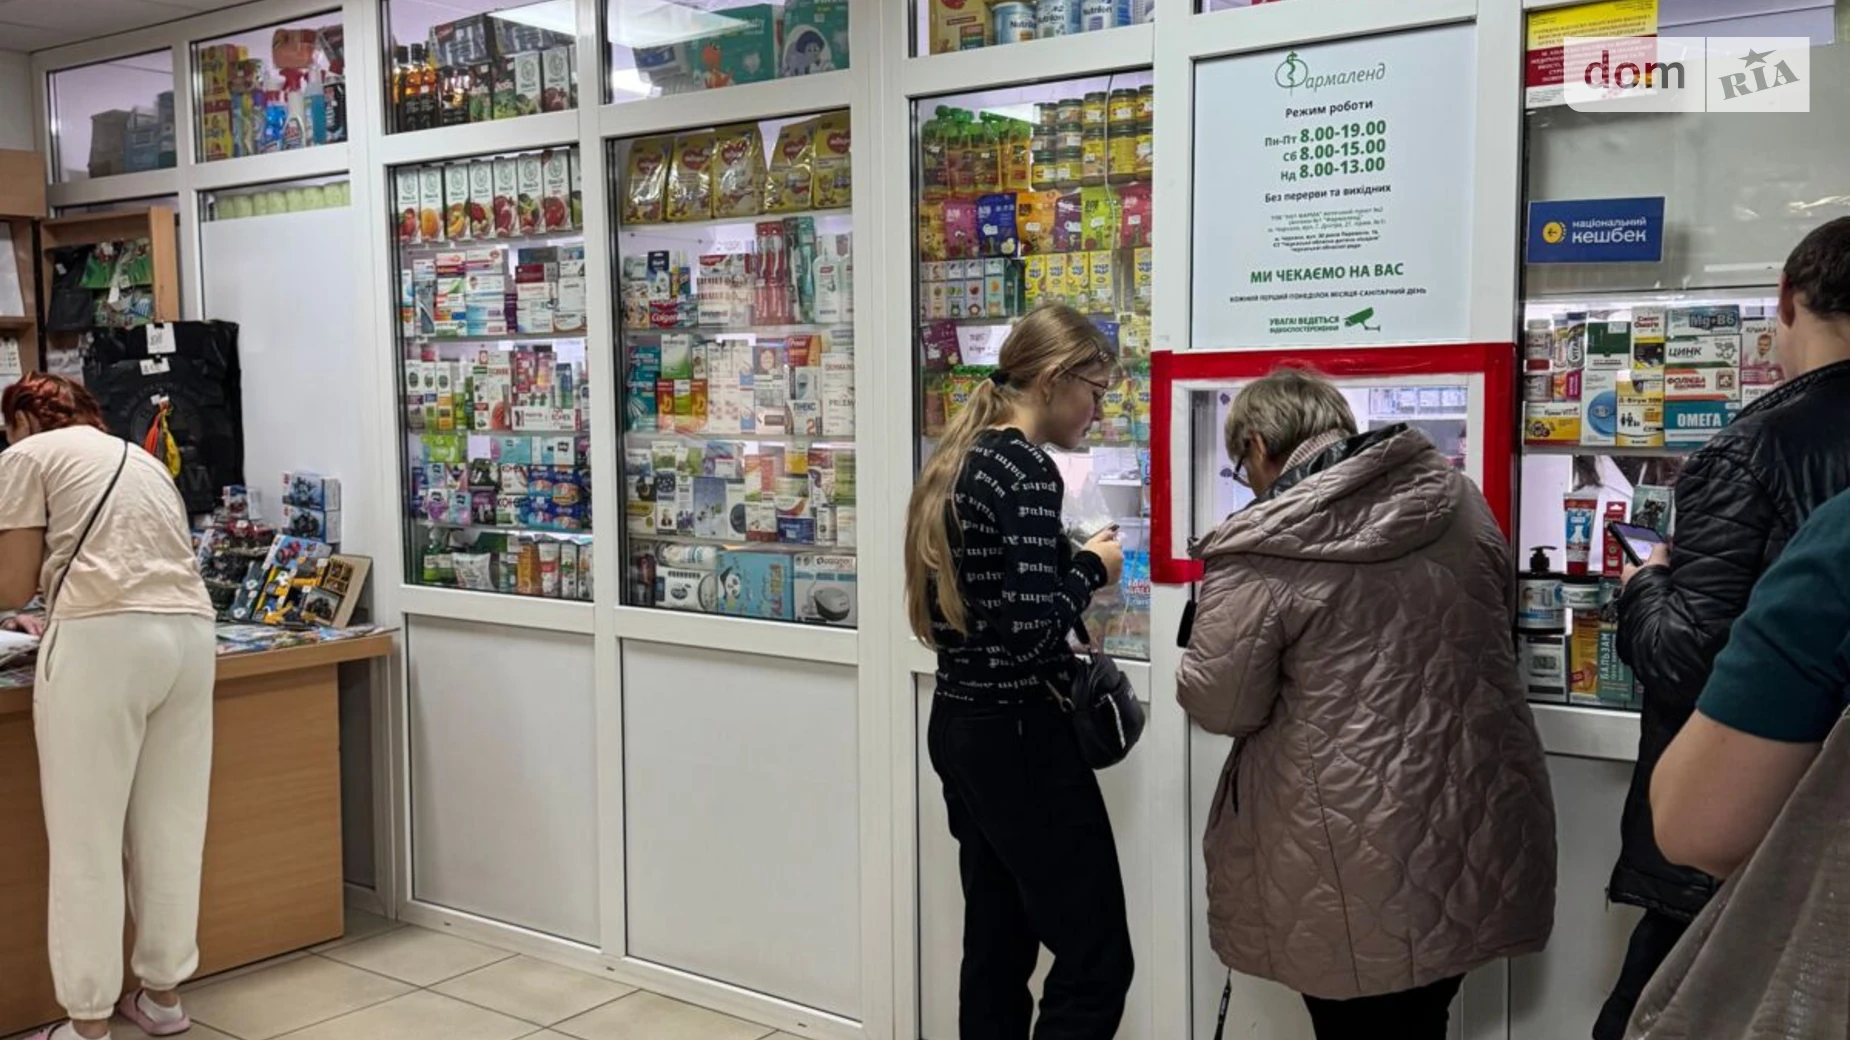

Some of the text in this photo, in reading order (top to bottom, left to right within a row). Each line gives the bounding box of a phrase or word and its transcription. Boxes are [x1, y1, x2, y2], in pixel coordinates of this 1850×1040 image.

[1285, 100, 1373, 118] Режим роботи
[1264, 119, 1386, 147] Пн-Пт 8.00-19.00
[1299, 138, 1386, 161] 8.00-15.00
[1280, 156, 1385, 182] Нд 8.00-13.00
[1264, 183, 1392, 203] Без перерви та вихідних
[1571, 217, 1647, 229] національний
[1571, 224, 1647, 244] кешбек
[1250, 262, 1404, 284] МИ ЧЕКАЄМО НА ВАС
[1269, 315, 1340, 326] УВАГА! ВЕДЕТЬСЯ
[1667, 346, 1703, 358] ЦИНК
[1676, 412, 1722, 428] ОМЕГА
[974, 470, 1006, 498] palm
[1017, 505, 1057, 518] palm
[1022, 535, 1058, 549] palm
[1017, 561, 1056, 575] palm
